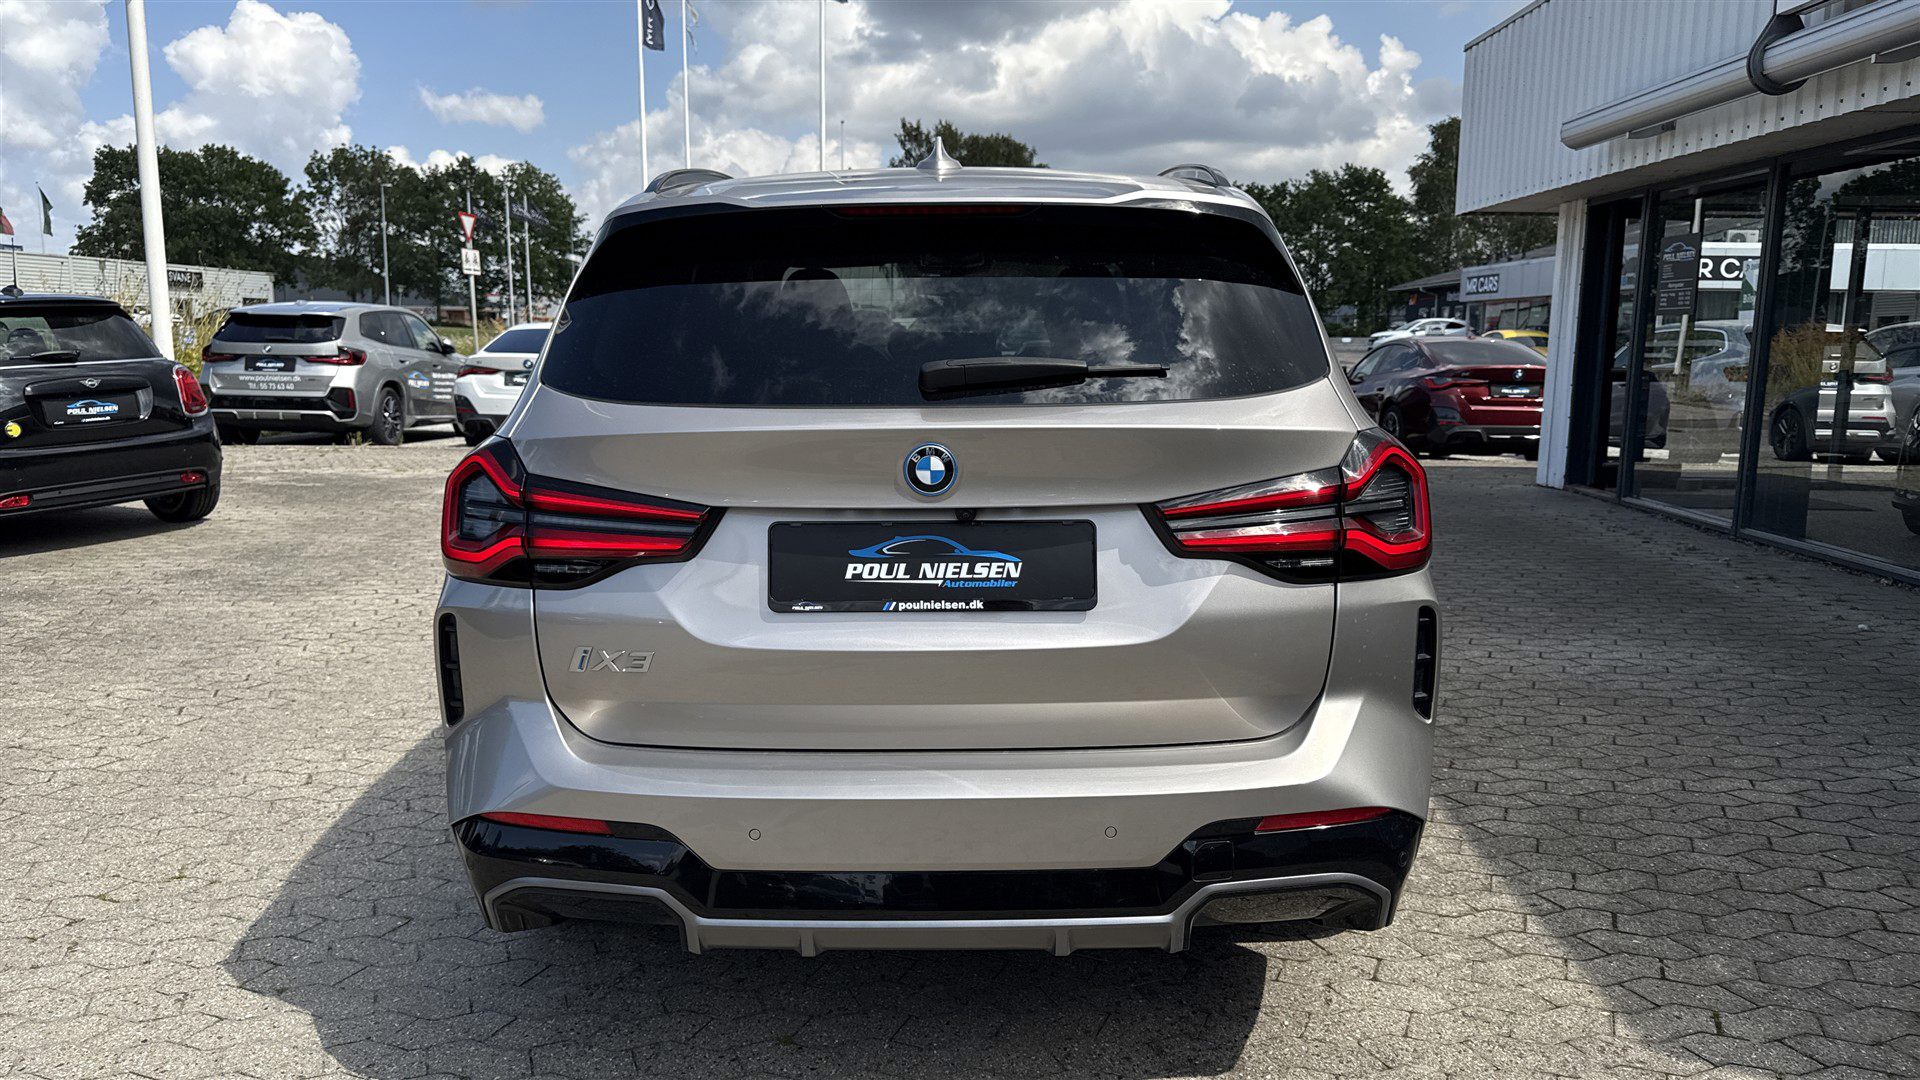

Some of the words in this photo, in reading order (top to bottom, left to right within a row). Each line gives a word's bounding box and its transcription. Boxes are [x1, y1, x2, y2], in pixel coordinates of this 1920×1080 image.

[1466, 277, 1477, 292] MR
[1478, 275, 1498, 292] CARS
[911, 447, 950, 463] BMW
[845, 563, 910, 580] POUL
[918, 562, 1022, 579] NIELSEN
[943, 579, 1018, 588] Automobiler
[898, 600, 984, 612] poulnielsen.dk
